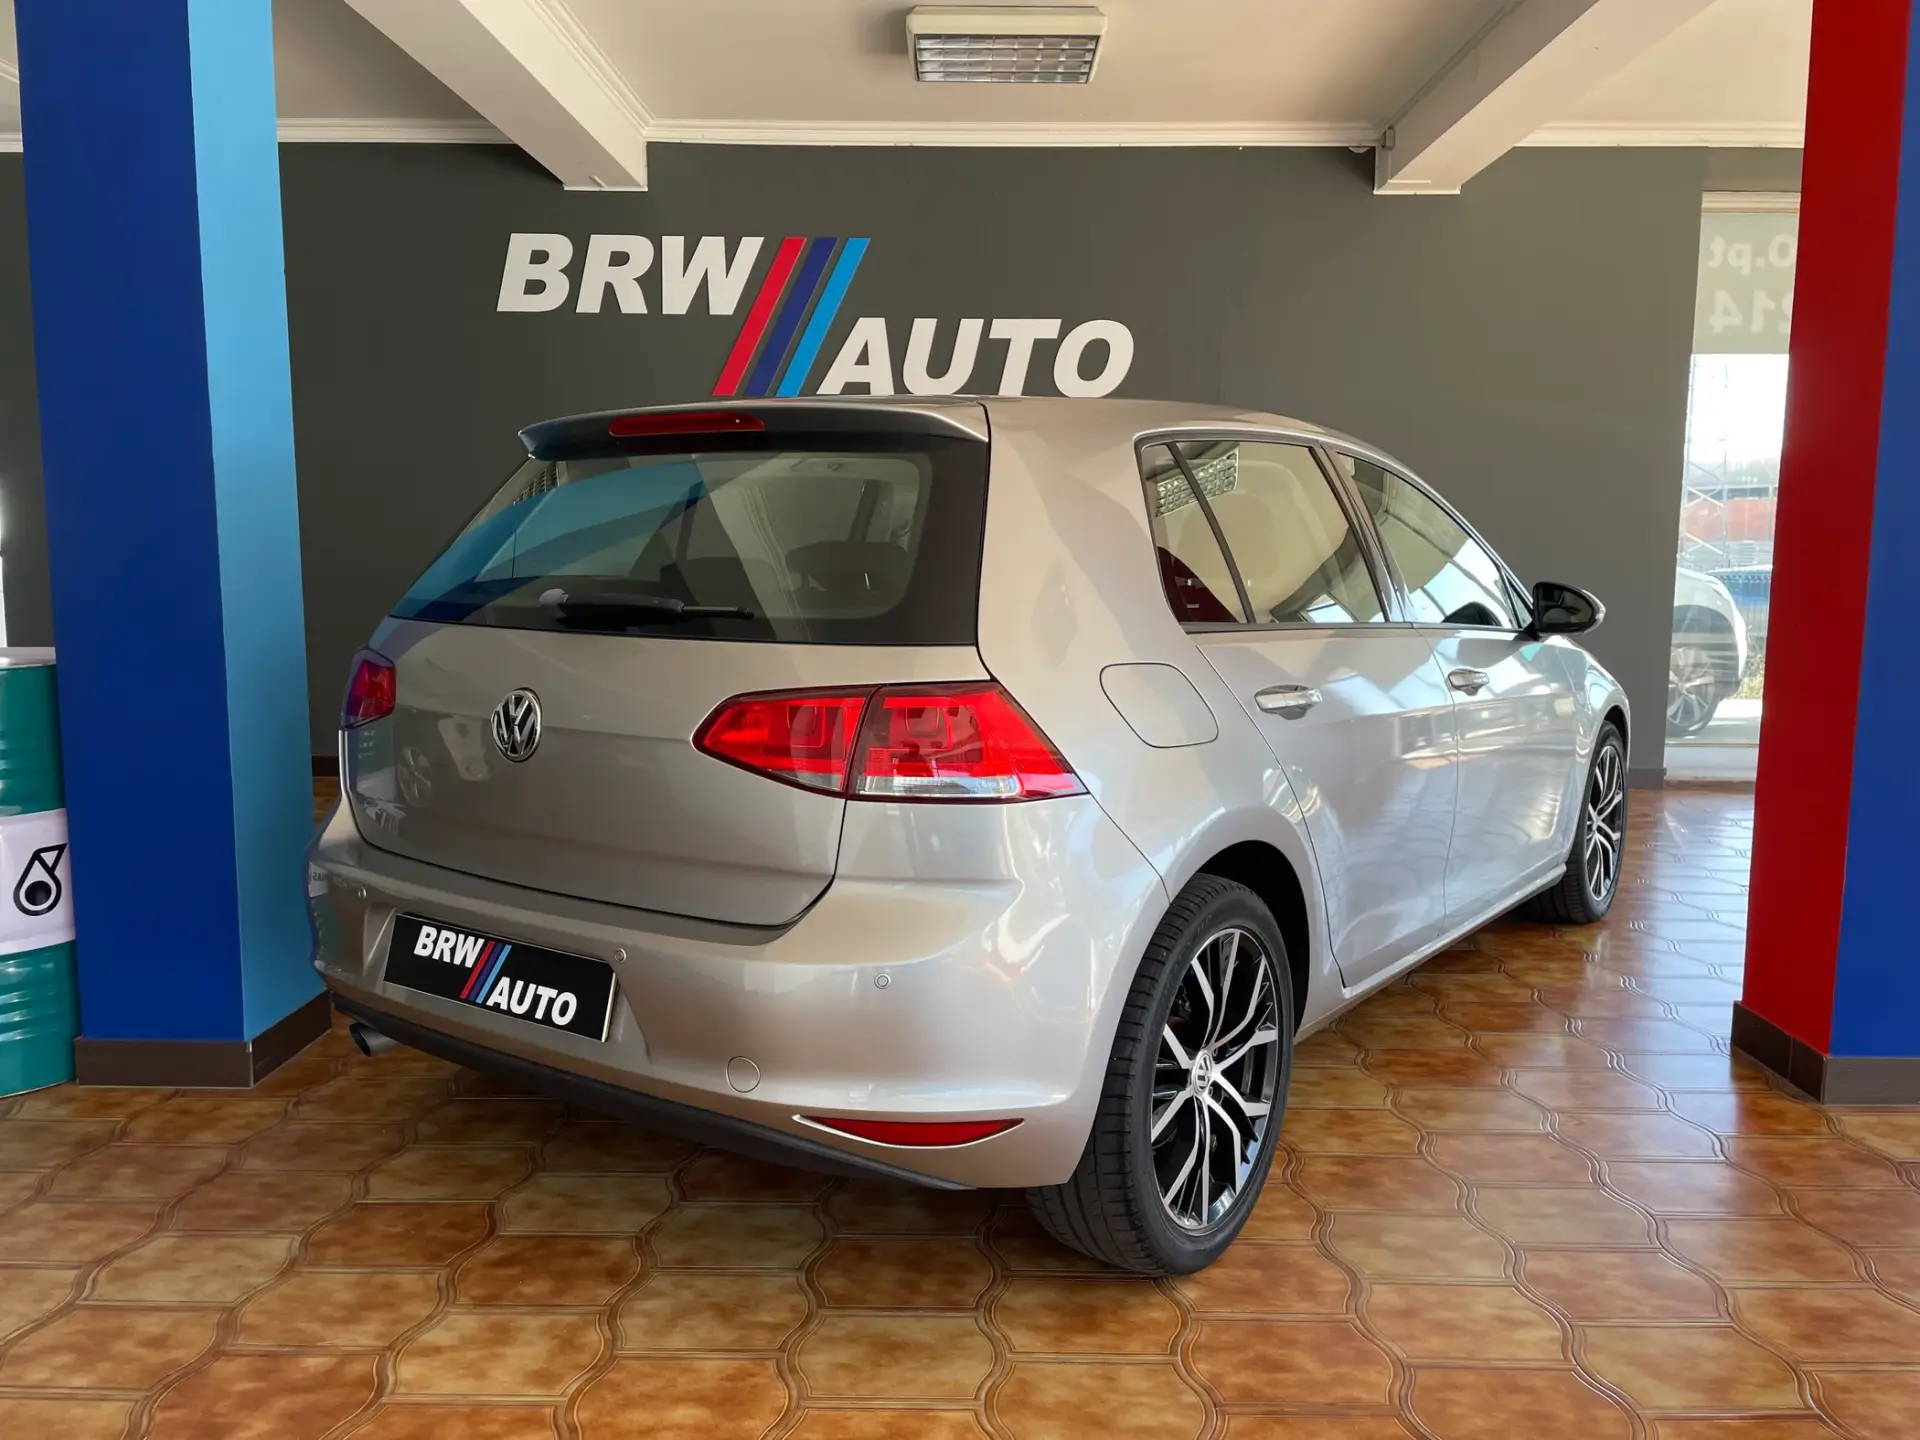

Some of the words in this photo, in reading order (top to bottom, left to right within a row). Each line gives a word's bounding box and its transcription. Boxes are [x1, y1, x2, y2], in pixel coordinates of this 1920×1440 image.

[496, 232, 764, 316] BRW
[816, 316, 1135, 398] AUTO
[413, 925, 485, 969] BRW
[486, 976, 578, 1026] AUTO
